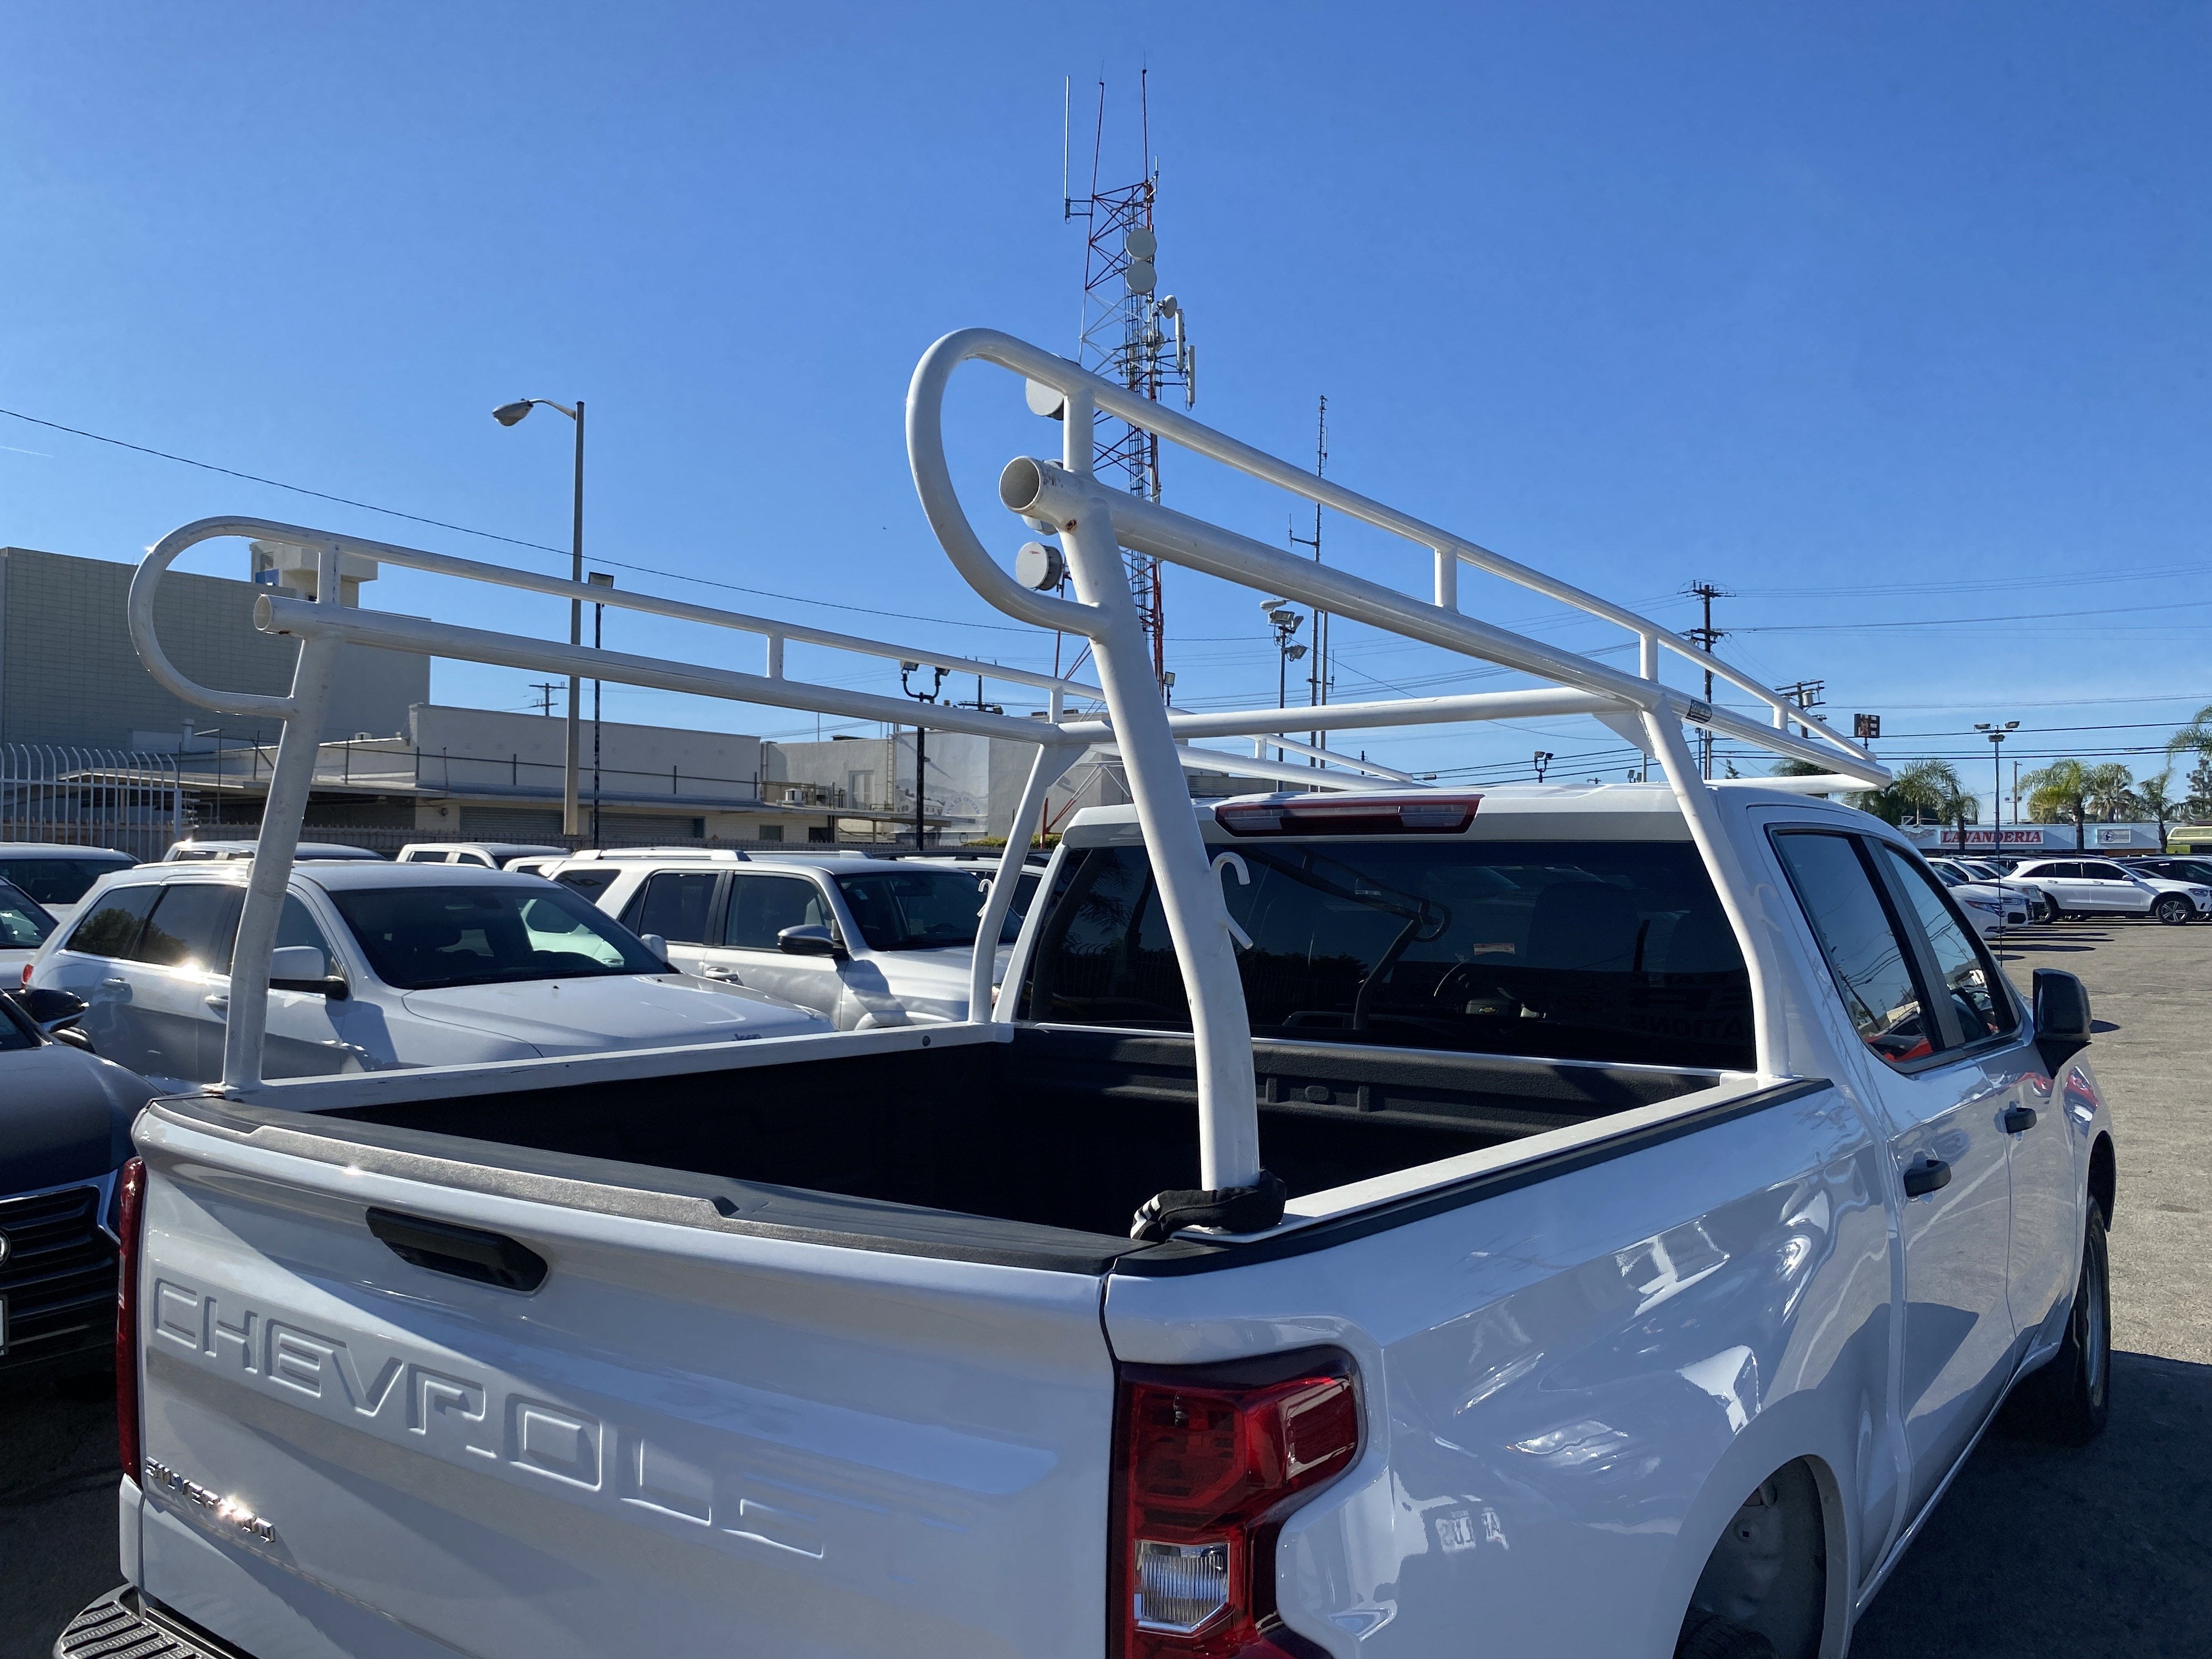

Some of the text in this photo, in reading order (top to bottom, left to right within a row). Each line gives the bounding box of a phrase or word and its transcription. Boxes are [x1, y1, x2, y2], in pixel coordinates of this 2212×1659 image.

[1942, 831, 2041, 843] LAVANDERIA
[154, 1277, 825, 1559] CHEVROLE
[145, 1456, 275, 1542] SILVERDO
